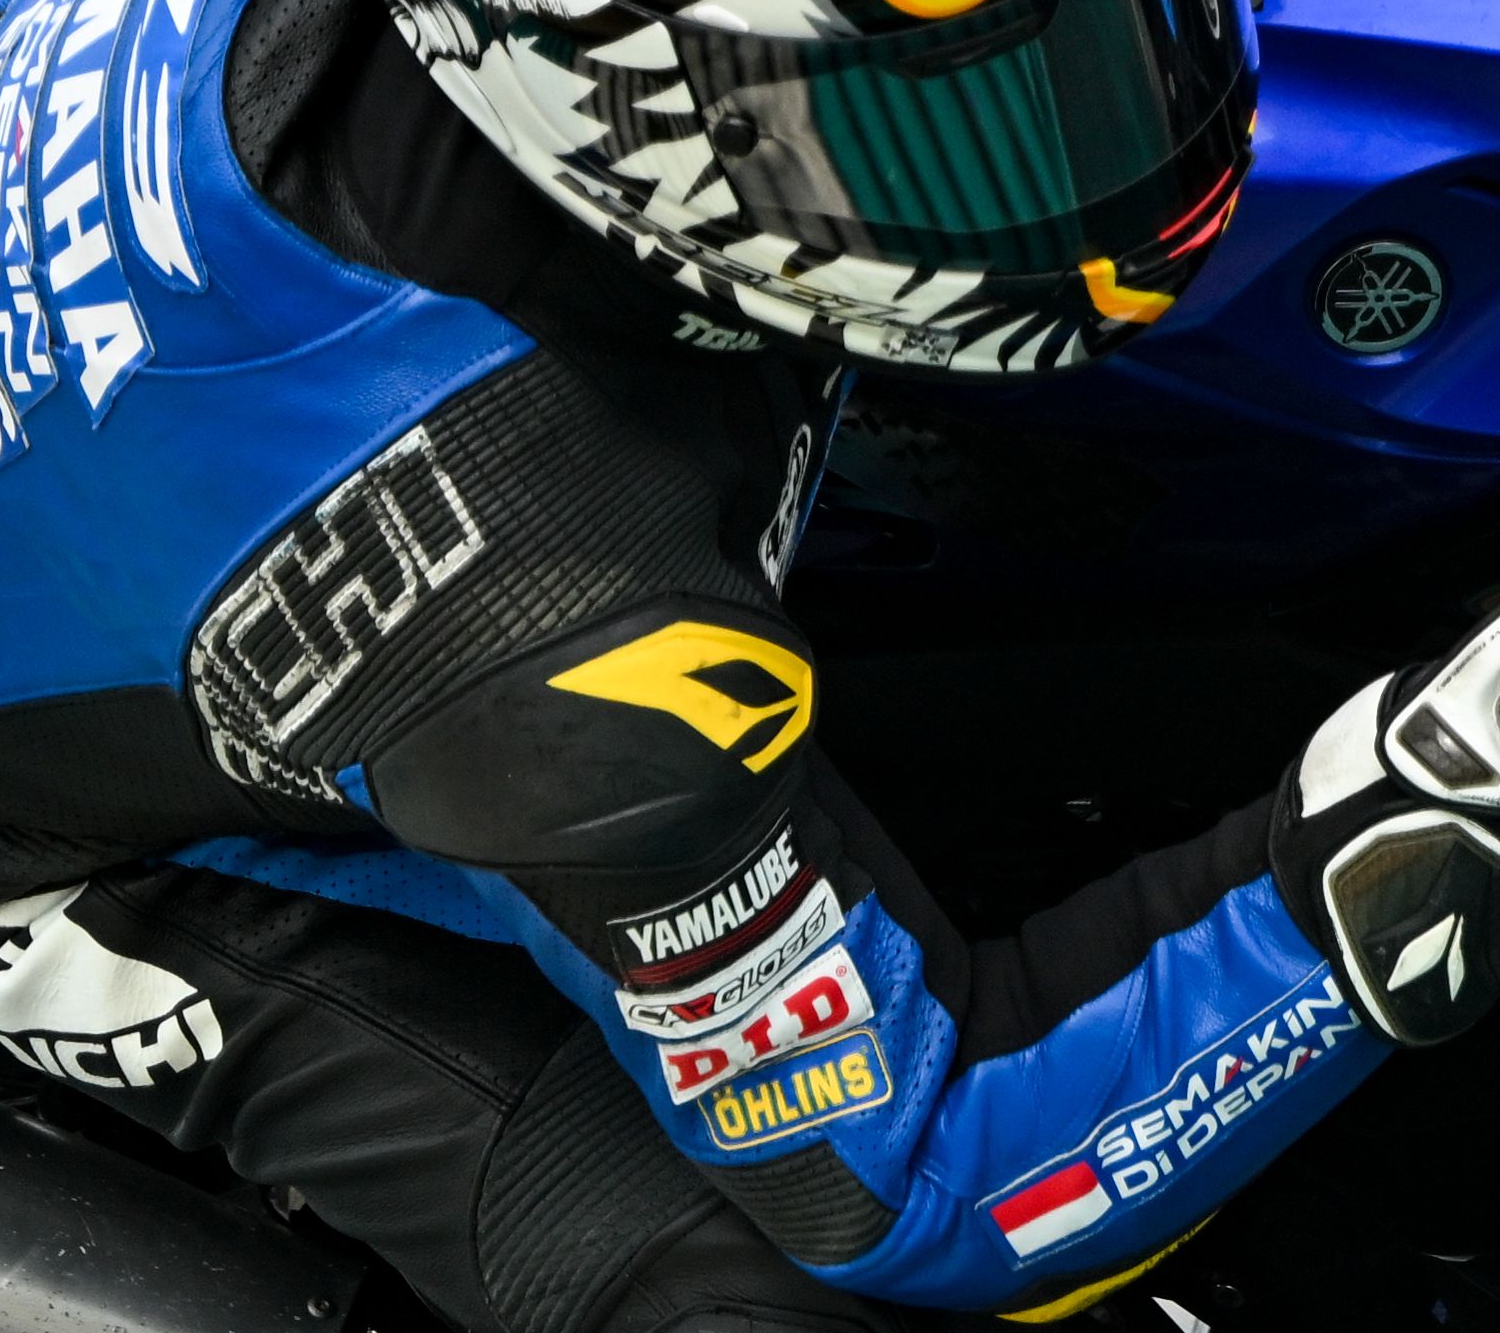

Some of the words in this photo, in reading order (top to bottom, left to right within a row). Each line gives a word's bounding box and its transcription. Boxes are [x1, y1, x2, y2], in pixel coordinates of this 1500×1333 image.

[626, 829, 799, 963] YAMALUBE
[713, 1052, 875, 1139] ÖHLINS
[1182, 1009, 1362, 1163] DEPAN
